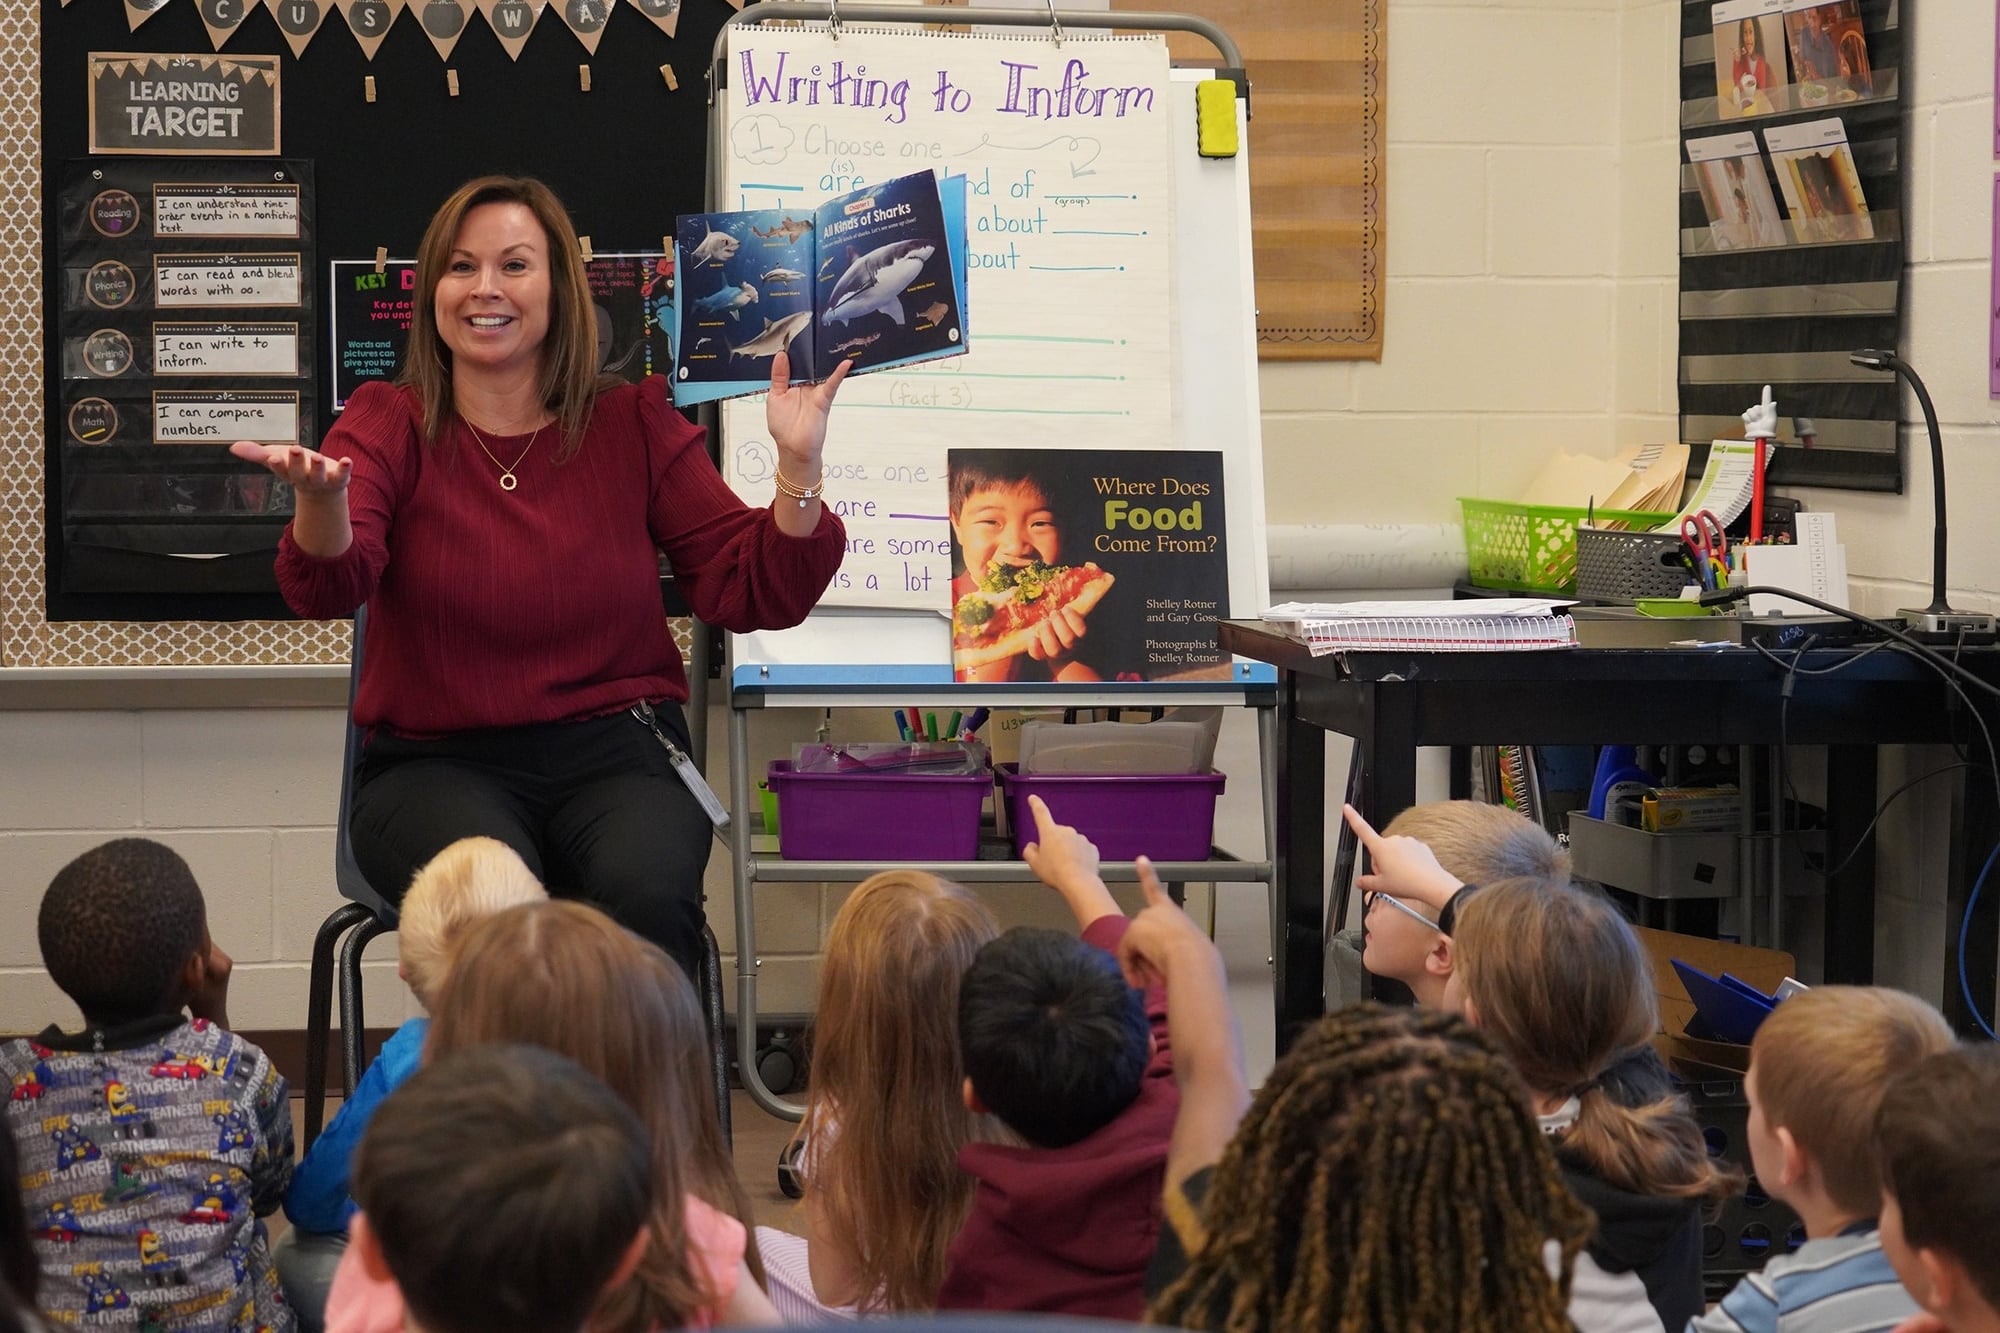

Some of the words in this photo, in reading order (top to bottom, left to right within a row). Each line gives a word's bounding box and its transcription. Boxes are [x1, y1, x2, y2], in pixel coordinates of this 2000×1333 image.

[130, 80, 239, 102] LEARNING
[739, 48, 910, 124] Writing
[932, 71, 972, 113] to
[996, 59, 1154, 120] Inform
[126, 106, 243, 137] TARGET
[804, 123, 886, 156] Choose
[900, 141, 943, 159] one
[830, 159, 855, 174] (is)
[819, 174, 865, 192] are
[1010, 169, 1037, 199] of
[173, 201, 192, 210] can
[197, 200, 258, 210] understand
[1054, 196, 1090, 208] (group)
[97, 209, 132, 219] Reading
[158, 211, 185, 221] order
[190, 211, 224, 221] events
[228, 211, 240, 220] in
[823, 225, 835, 240] All
[833, 215, 859, 234] Kinds
[860, 212, 872, 227] of
[873, 202, 912, 223] Sharks
[977, 204, 1049, 234] about
[160, 223, 184, 233] text.
[967, 241, 1021, 270] bout
[177, 272, 199, 281] can
[206, 268, 235, 280] read
[242, 267, 264, 279] and
[267, 268, 295, 279] blend
[95, 280, 127, 292] Phonics
[355, 272, 388, 292] KEY
[160, 285, 198, 296] words
[206, 284, 234, 296] with
[373, 300, 393, 310] Key
[395, 300, 414, 309] det
[370, 311, 390, 321] you
[392, 311, 412, 320] und
[159, 338, 171, 351] I
[178, 340, 203, 351] can
[211, 337, 245, 350] write
[252, 337, 269, 349] to
[92, 349, 125, 361] Writing
[159, 354, 207, 367] inform.
[343, 350, 378, 359] pictures
[343, 359, 363, 369] give
[364, 360, 379, 369] you
[379, 359, 396, 368] key
[354, 368, 385, 376] details.
[889, 384, 939, 408] (fact
[950, 386, 973, 408] 3)
[158, 406, 170, 418] I
[179, 408, 201, 418] can
[208, 407, 265, 422] compare
[82, 417, 105, 427] Math
[161, 422, 221, 436] numbers.
[745, 448, 766, 477] 3
[883, 464, 929, 483] one
[1093, 477, 1156, 496] Where
[1162, 478, 1211, 496] Does
[834, 500, 877, 518] are
[1104, 500, 1203, 531] Food
[887, 538, 952, 556] some
[1094, 535, 1152, 553] Come
[1157, 535, 1218, 553] From?
[865, 574, 879, 591] a
[903, 561, 932, 592] lot
[1146, 599, 1181, 611] Shelley
[1183, 599, 1217, 610] Rotner
[1146, 613, 1165, 623] and
[1167, 613, 1191, 625] Gary
[1193, 613, 1218, 623] Goss
[1146, 639, 1207, 652] Photographs
[1148, 653, 1184, 665] Shelley
[1186, 653, 1220, 663] Rotner
[42, 1114, 71, 1133] EPIC
[71, 1193, 107, 1216] EPIC
